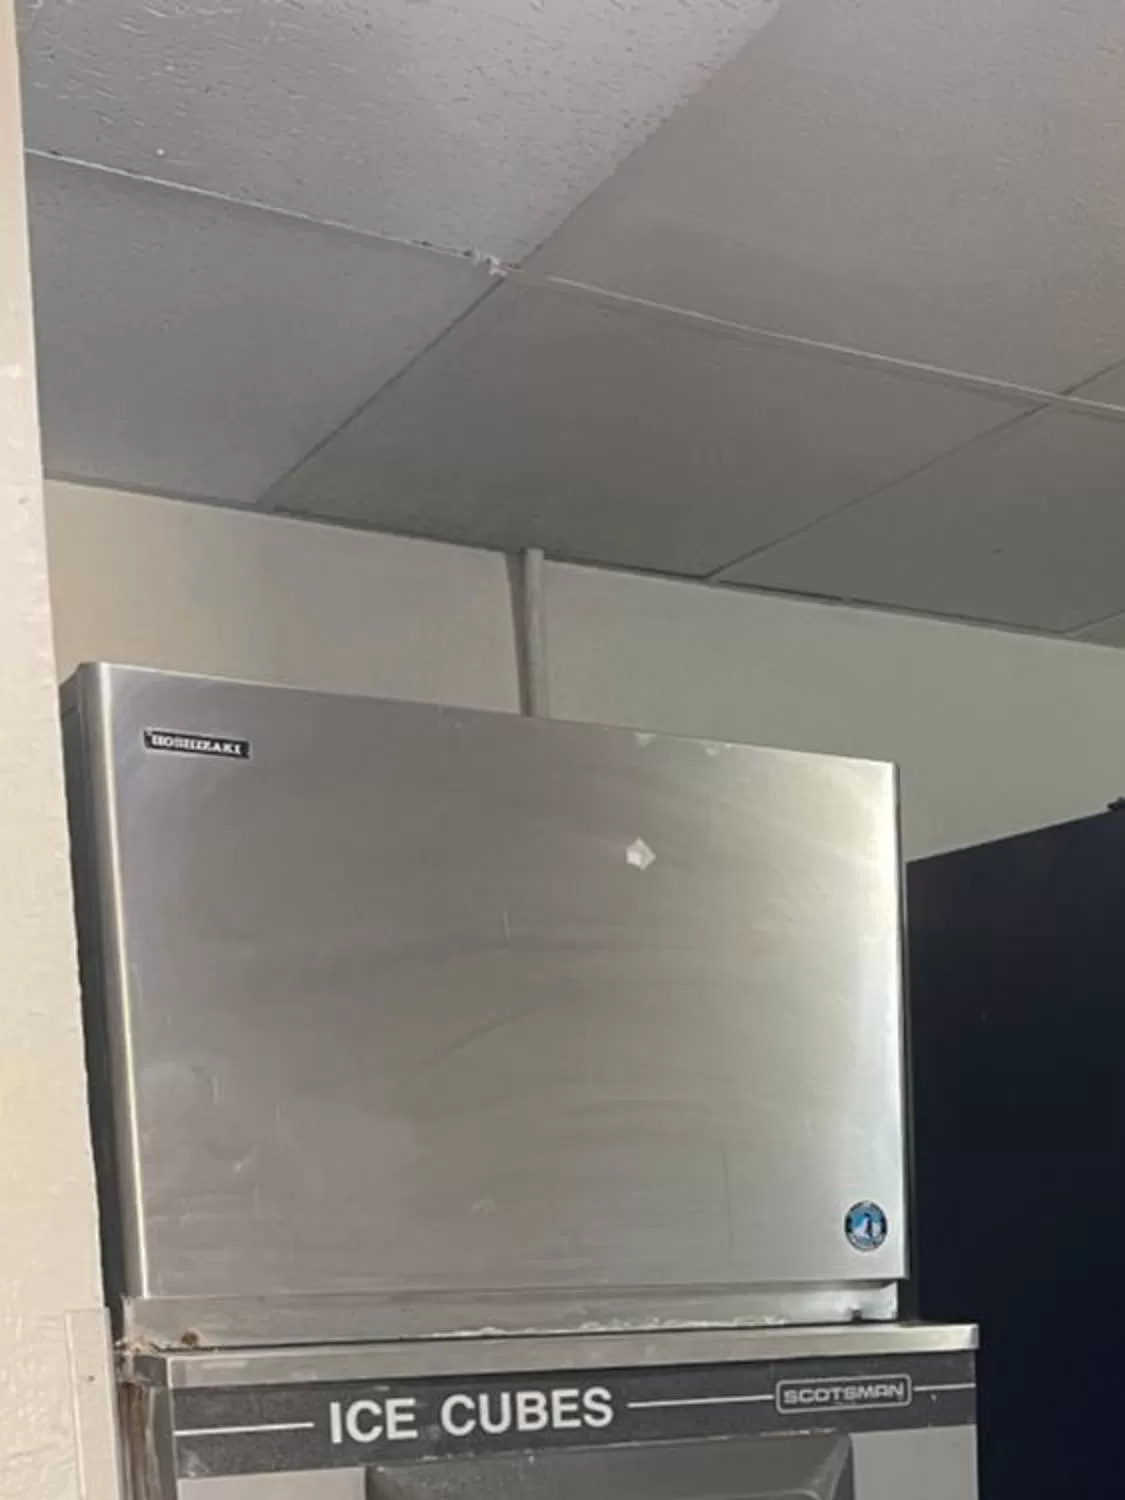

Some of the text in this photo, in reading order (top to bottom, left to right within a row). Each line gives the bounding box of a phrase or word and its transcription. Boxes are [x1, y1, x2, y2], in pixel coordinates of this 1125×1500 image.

[151, 733, 242, 755] HOSHIZAKI
[783, 1380, 904, 1405] SCOTSMAN
[329, 1386, 615, 1443] ICE CUBES
